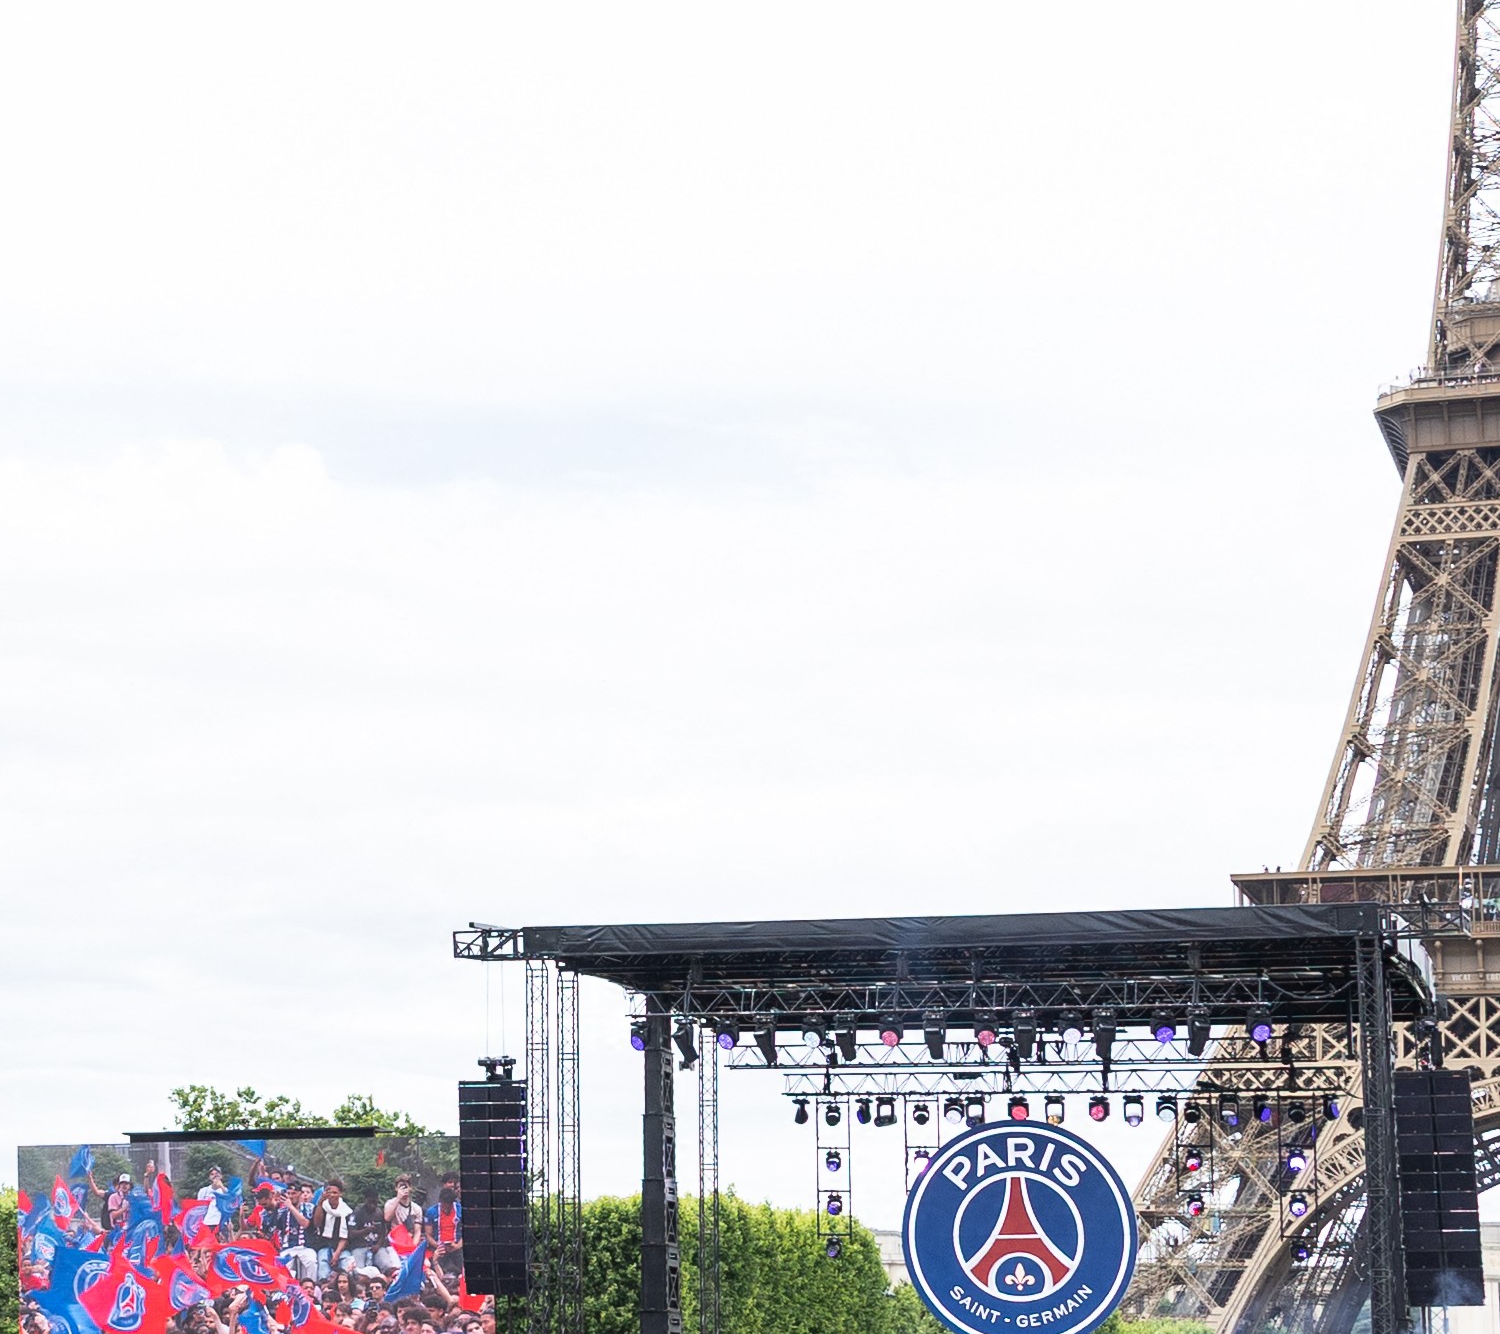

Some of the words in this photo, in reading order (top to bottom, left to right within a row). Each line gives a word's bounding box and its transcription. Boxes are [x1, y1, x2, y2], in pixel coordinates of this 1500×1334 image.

[942, 1137, 1087, 1190] PARIS
[949, 1286, 1001, 1324] SAINT
[1016, 1284, 1093, 1328] GERMAIN
